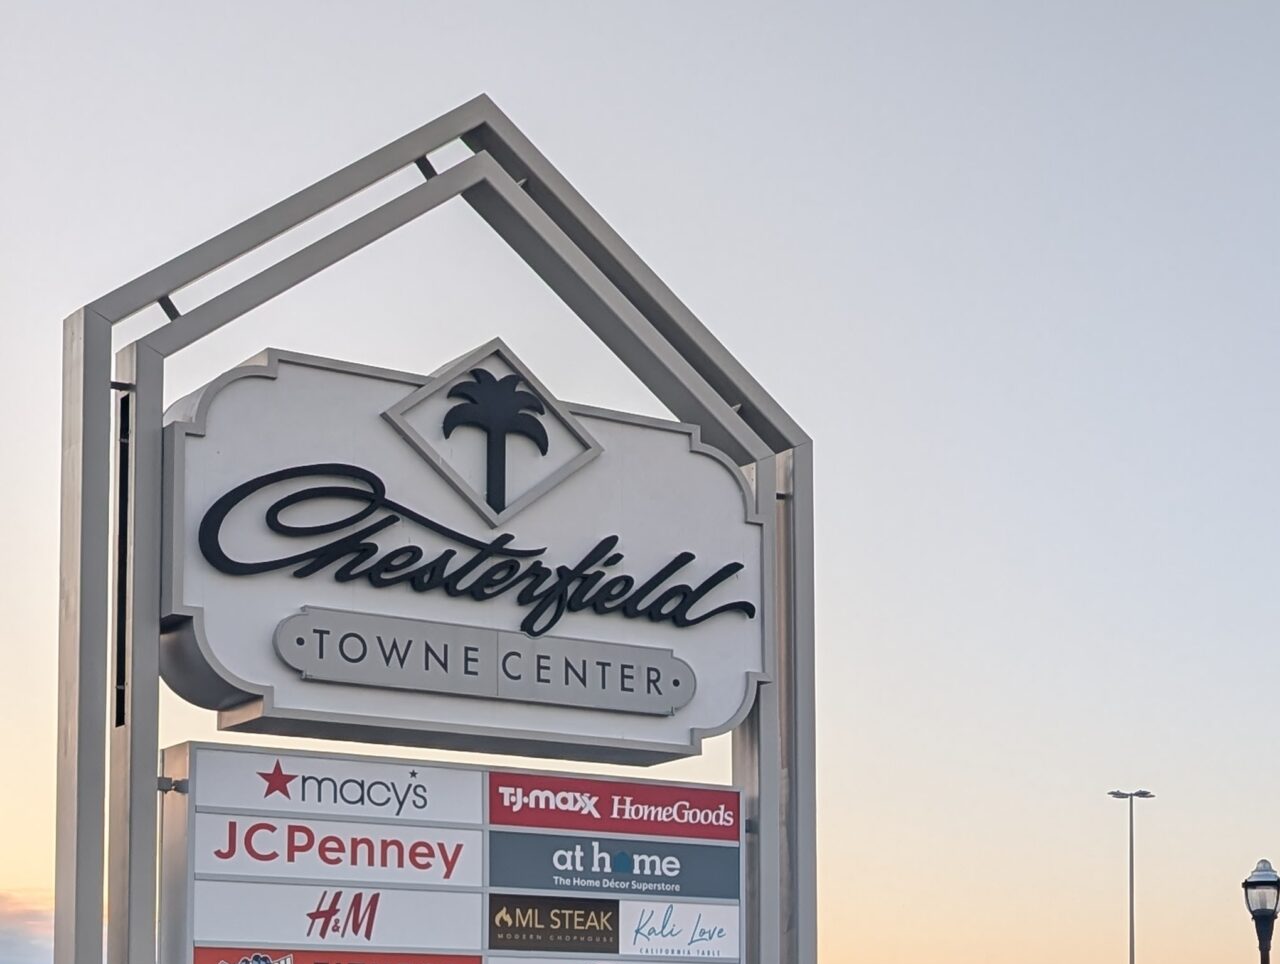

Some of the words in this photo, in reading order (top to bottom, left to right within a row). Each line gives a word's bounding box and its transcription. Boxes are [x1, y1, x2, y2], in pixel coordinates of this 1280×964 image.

[199, 463, 755, 637] Chesterfield
[312, 628, 480, 676] TOWNE
[501, 650, 663, 695] CENTER
[301, 769, 428, 816] macy's
[609, 795, 735, 827] HomeGoods
[213, 820, 464, 879] JCPenney
[552, 844, 584, 872] at
[553, 875, 571, 886] The
[572, 877, 600, 888] Home
[631, 880, 680, 892] Superstore
[306, 890, 381, 941] H&M
[515, 907, 545, 929] ML
[549, 909, 613, 931] STEAK
[633, 904, 683, 946] Kali
[687, 913, 727, 946] Love
[497, 933, 542, 941] MODERN
[549, 934, 614, 943] CHOPHOUSE
